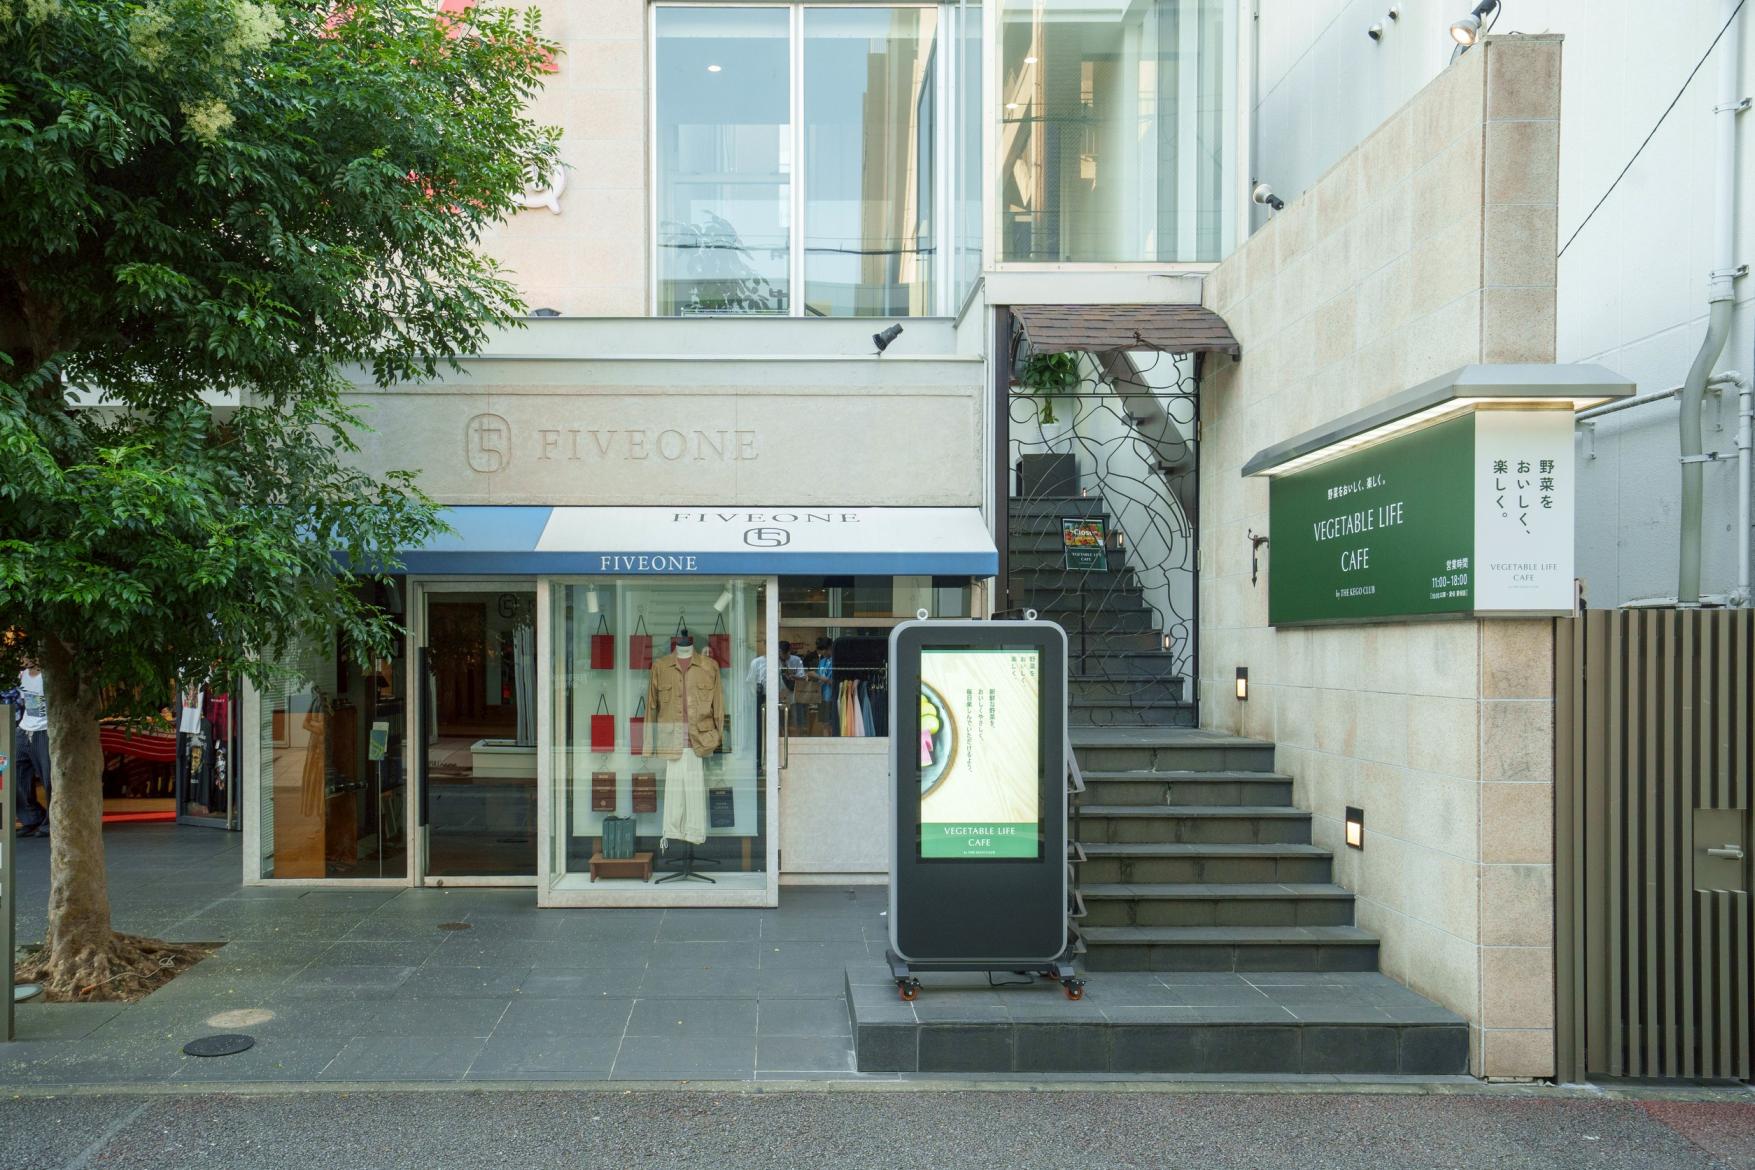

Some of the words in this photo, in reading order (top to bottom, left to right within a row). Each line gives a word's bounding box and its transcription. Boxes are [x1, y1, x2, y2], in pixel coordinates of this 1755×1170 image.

[537, 429, 759, 461] FIVEONE
[1493, 459, 1508, 518] 楽しく。
[1539, 459, 1555, 509] 野菜を
[1517, 460, 1531, 535] おいしく、
[672, 513, 860, 523] FIVEONE
[1313, 509, 1374, 541] VEGETABLE
[1379, 502, 1403, 528] LIFE
[600, 555, 698, 571] FIVEONE
[1341, 548, 1369, 572] CAFE
[1490, 563, 1537, 571] VEGETABLE
[1541, 563, 1559, 571] LIFE
[944, 827, 995, 835] VEGETABLE
[998, 827, 1016, 835] LIFE
[968, 838, 992, 847] CAFE
